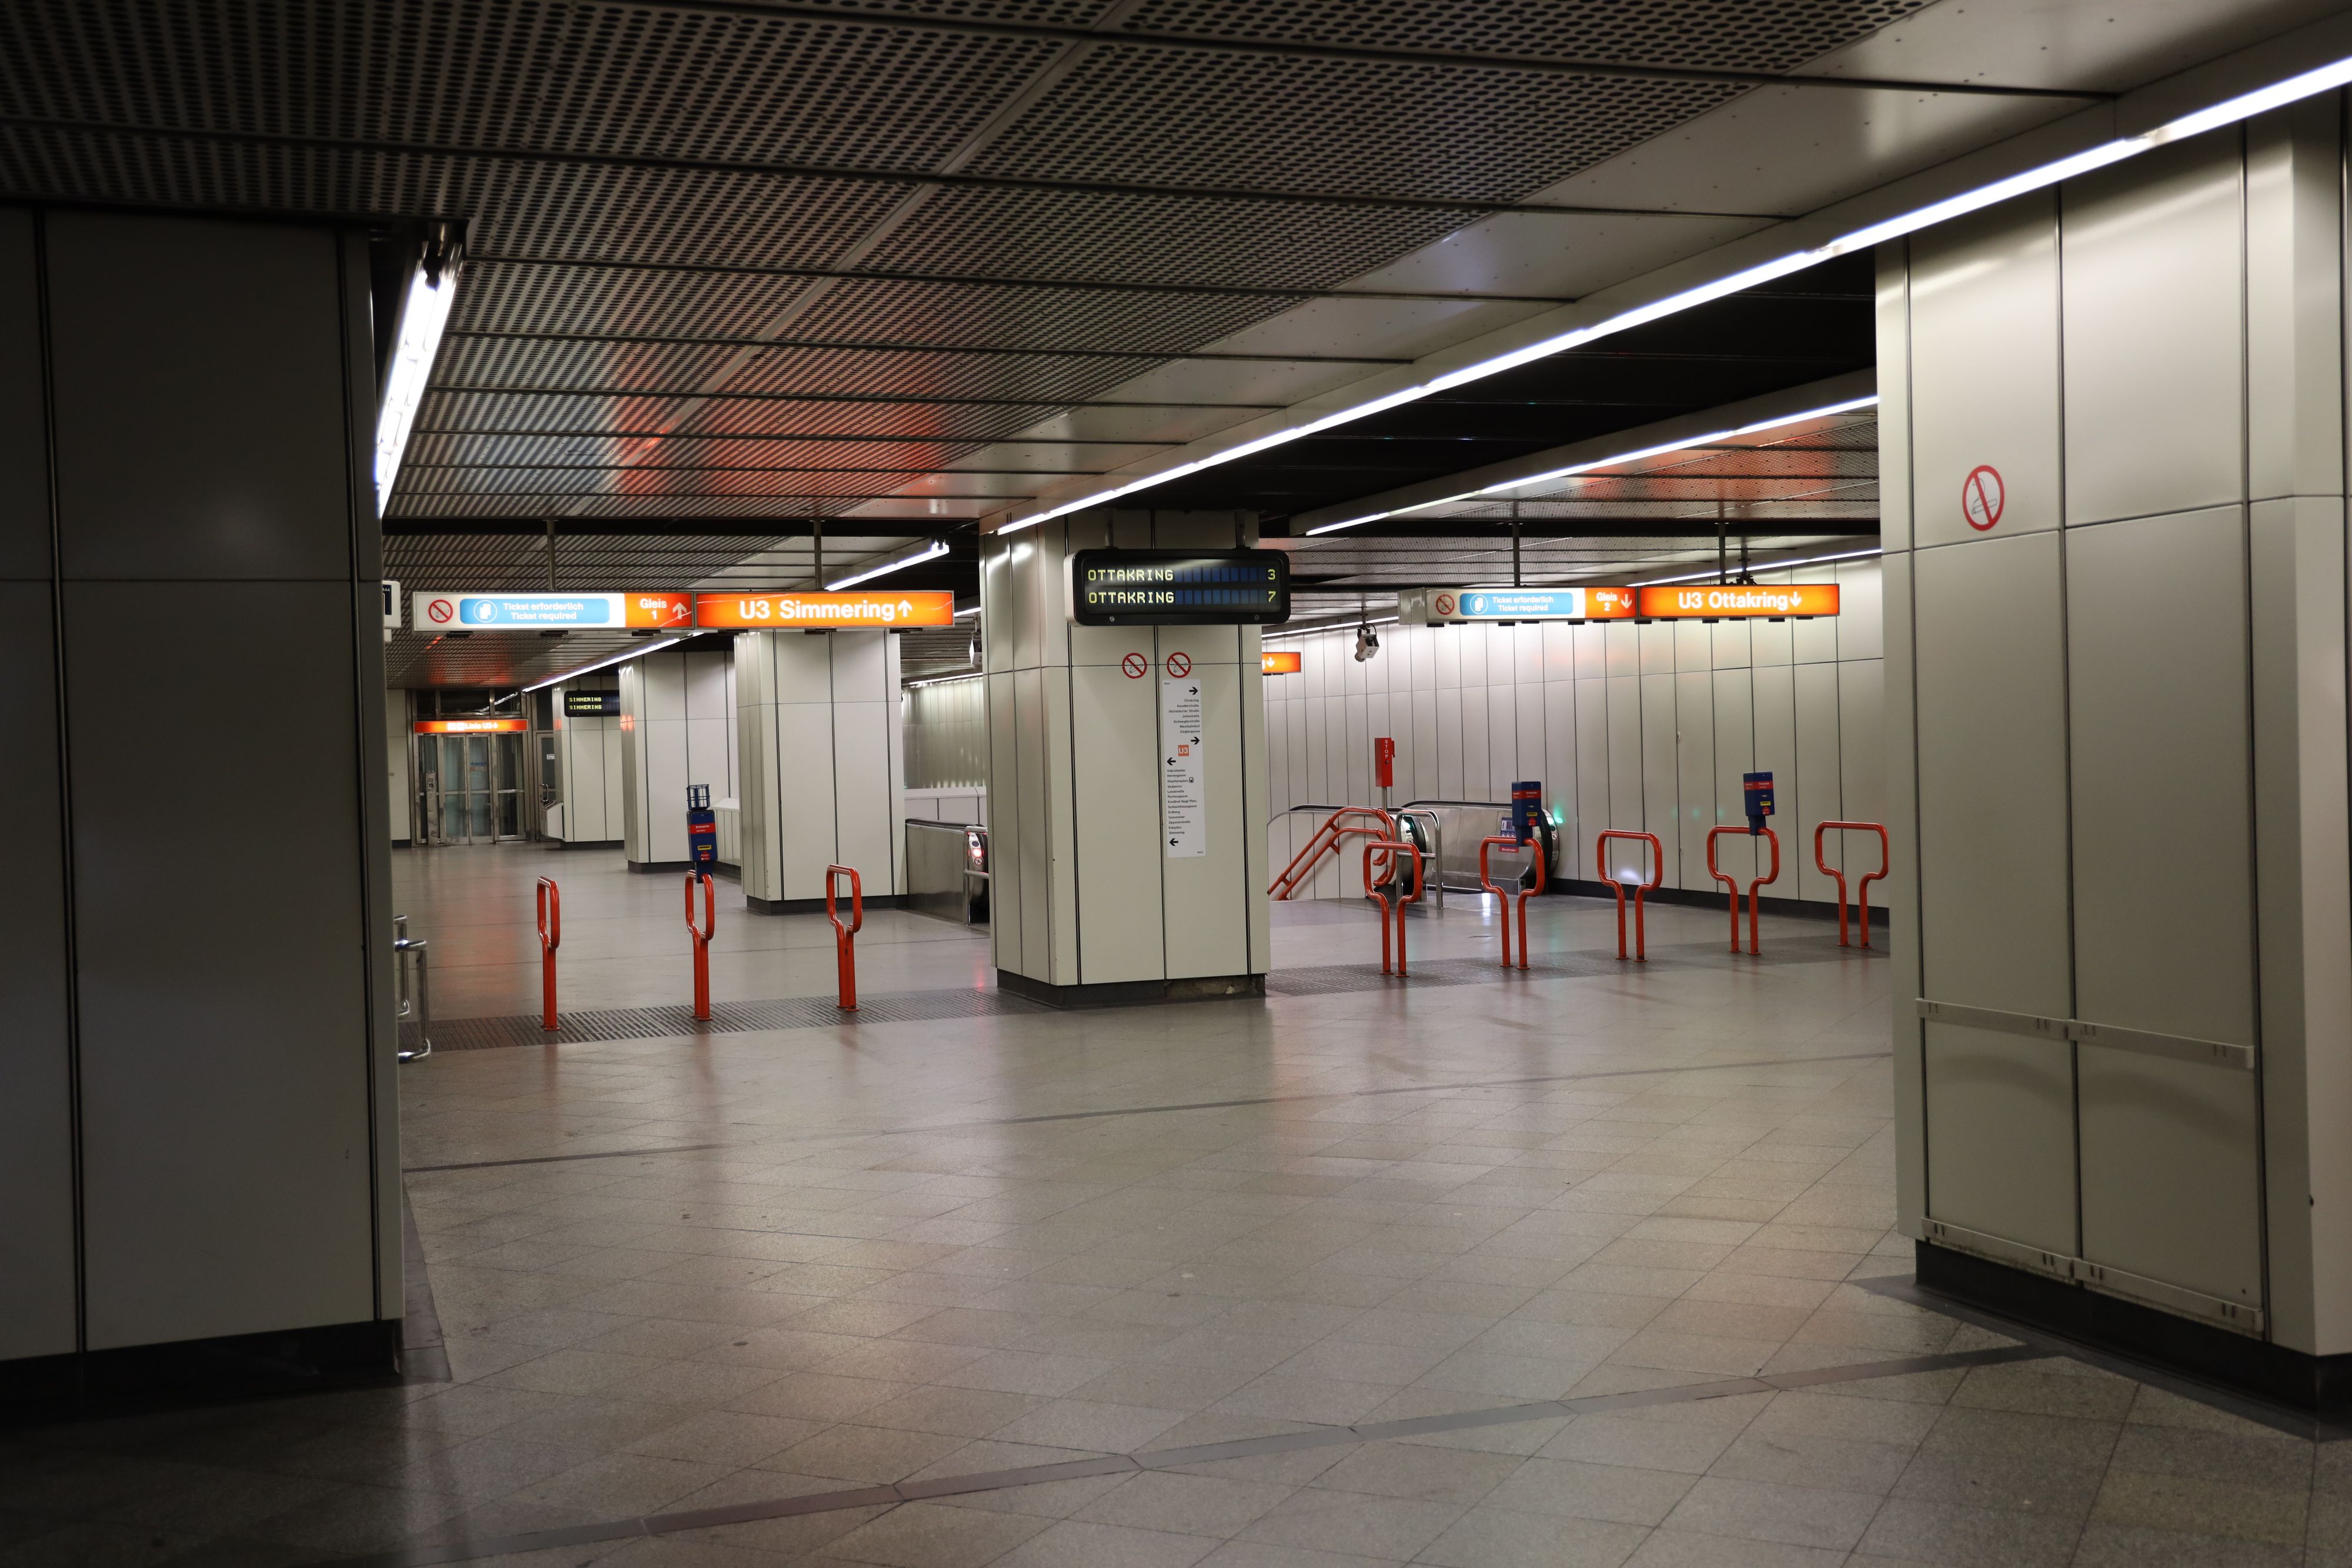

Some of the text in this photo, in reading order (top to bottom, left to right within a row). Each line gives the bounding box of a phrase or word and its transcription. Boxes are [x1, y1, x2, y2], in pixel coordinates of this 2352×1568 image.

[1088, 569, 1276, 581] OTTAKRING 3
[1088, 591, 1277, 604] OTTAKRING 7
[1596, 592, 1618, 601] Gleis
[1679, 591, 1788, 611] U3 Ottakring
[531, 602, 584, 610] erforderlich
[640, 598, 667, 609] Gleis
[1519, 604, 1548, 613] required
[1604, 602, 1610, 611] 2
[652, 610, 657, 620] 1
[739, 600, 894, 621] U3 Simmering
[539, 611, 576, 621] required
